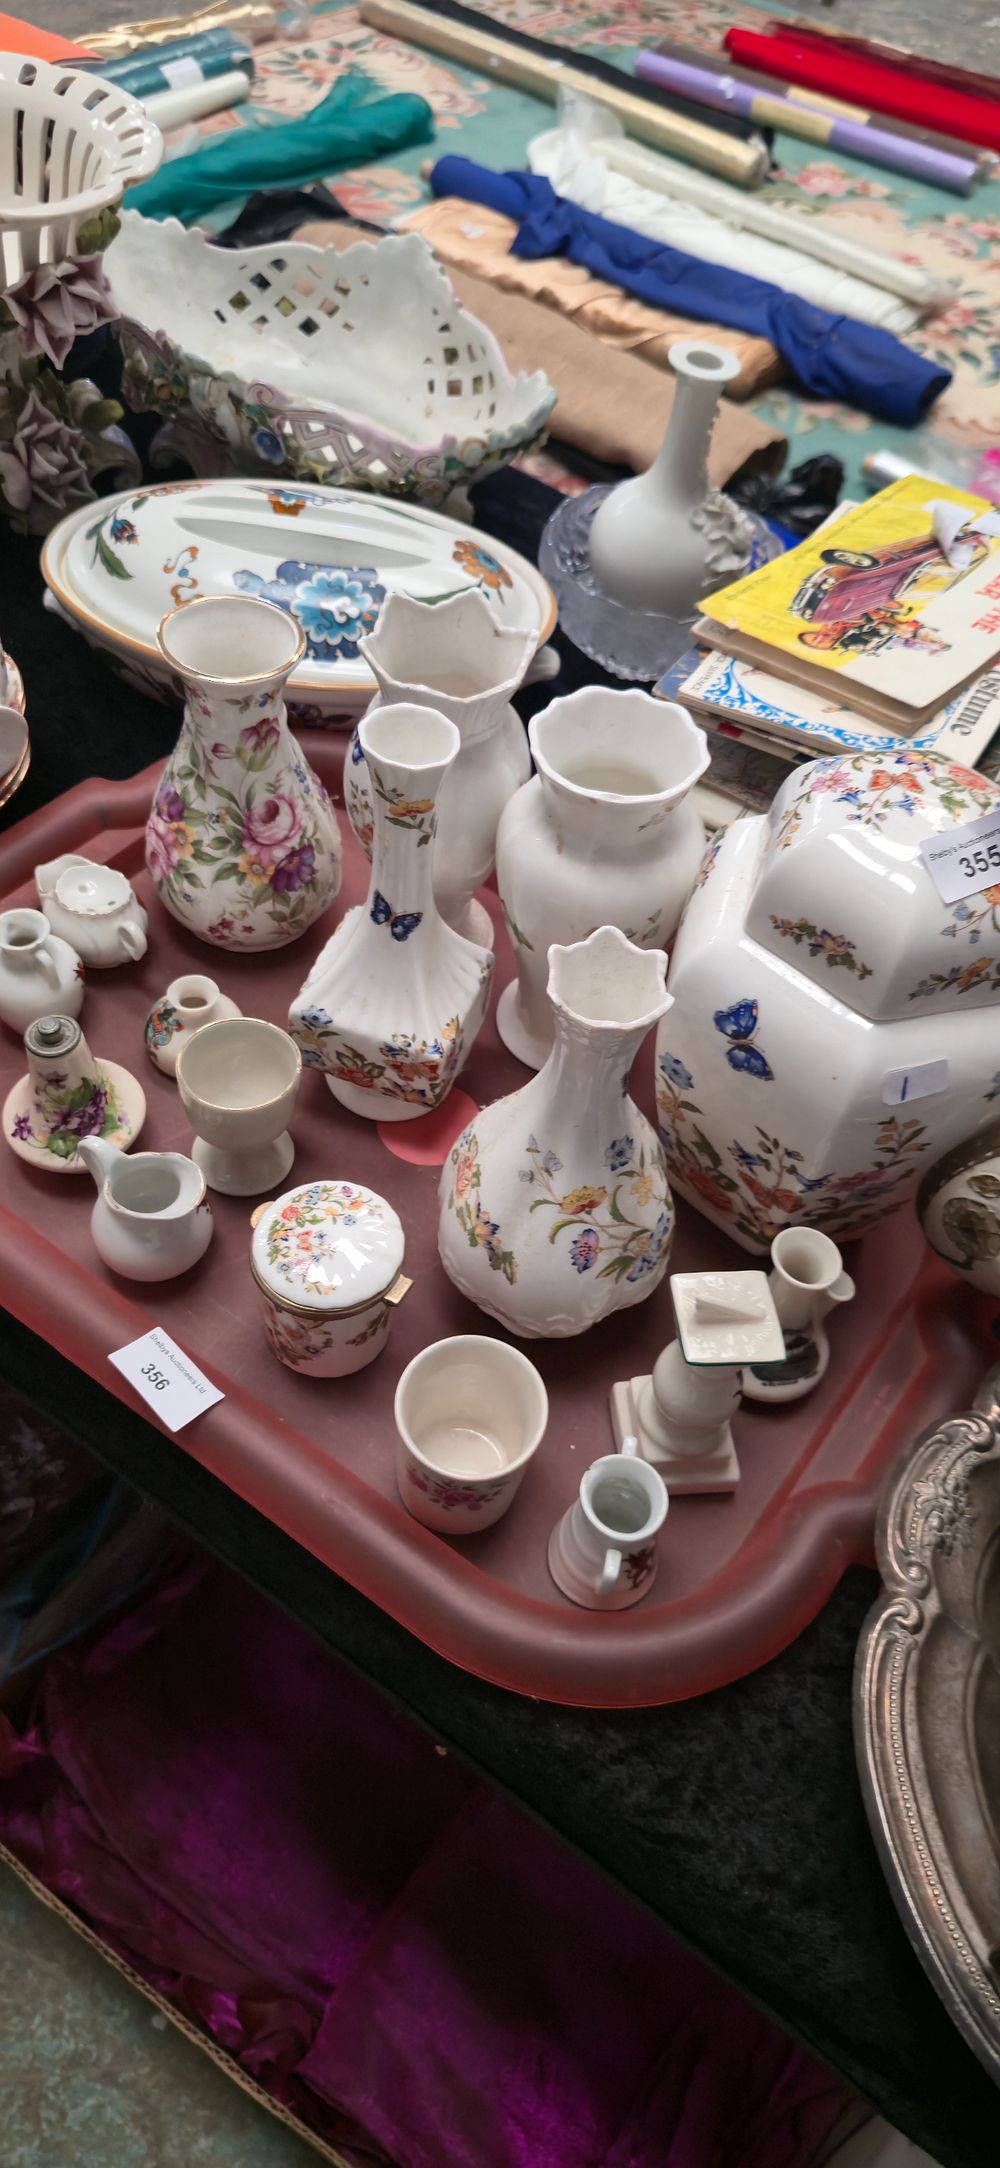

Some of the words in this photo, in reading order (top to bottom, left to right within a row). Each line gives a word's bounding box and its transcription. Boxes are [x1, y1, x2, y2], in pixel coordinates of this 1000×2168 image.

[950, 669, 1000, 736] ostume
[959, 844, 1000, 878] 355
[141, 1363, 170, 1391] 356
